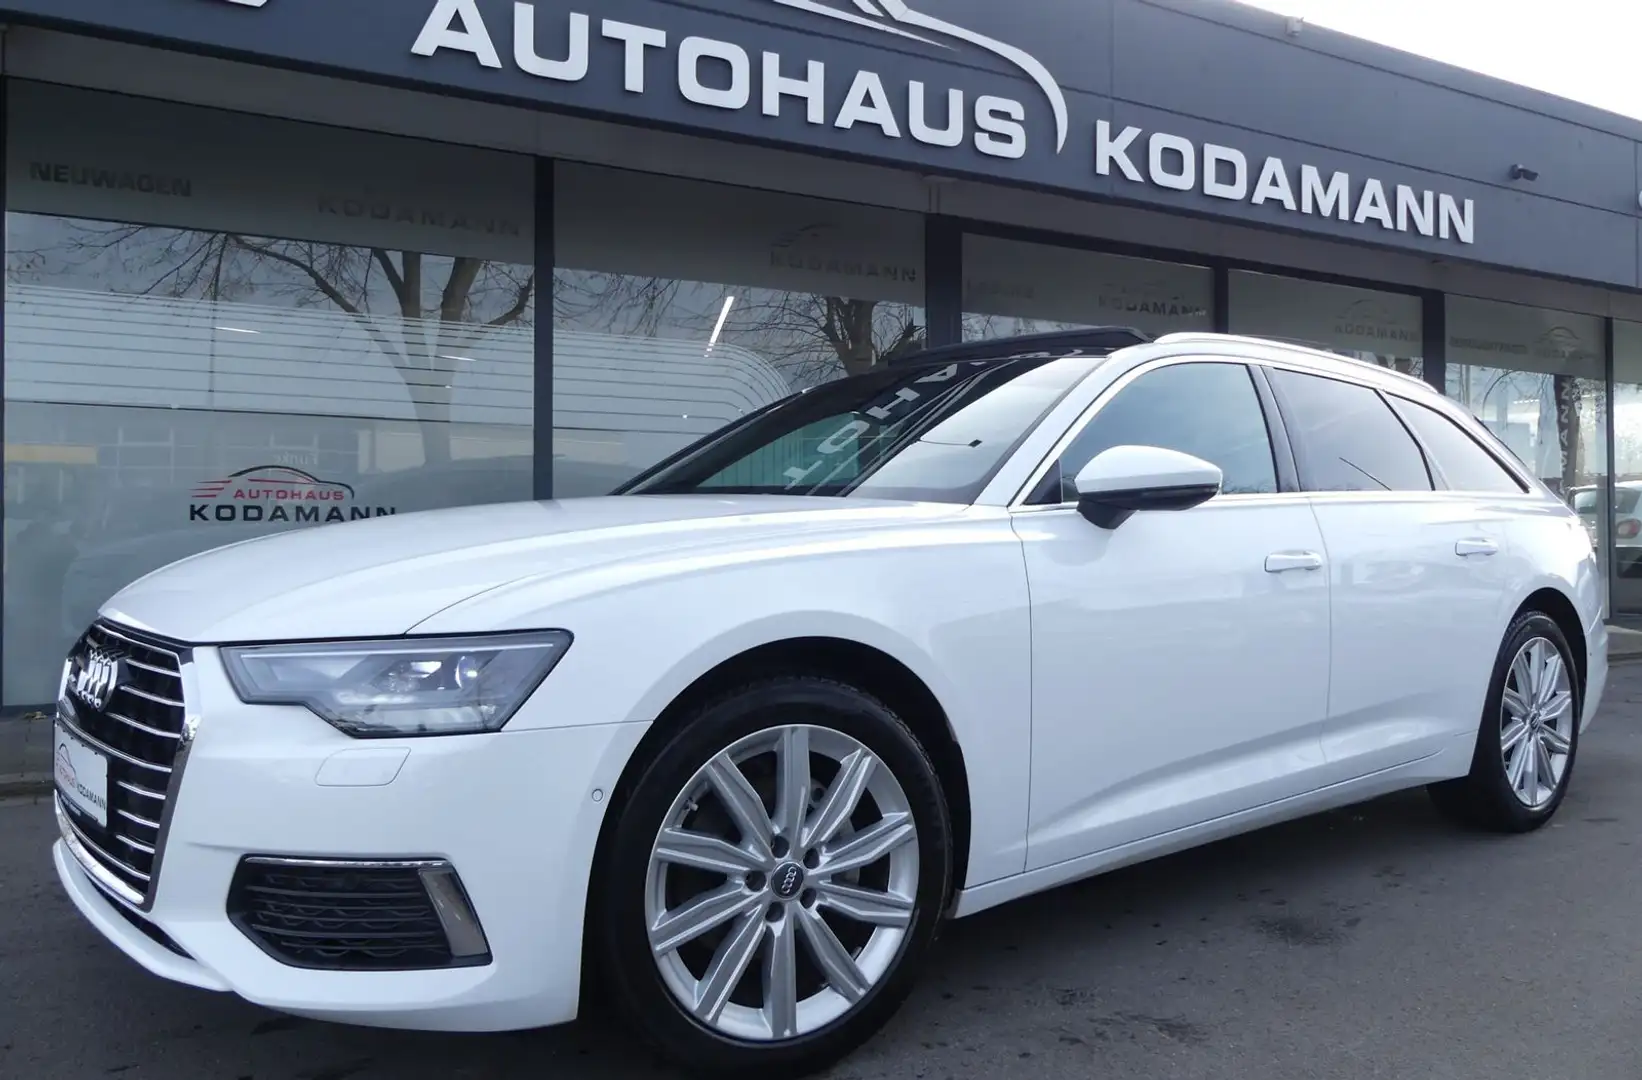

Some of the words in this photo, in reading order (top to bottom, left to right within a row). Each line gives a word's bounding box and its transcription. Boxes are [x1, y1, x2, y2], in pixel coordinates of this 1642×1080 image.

[411, 0, 1027, 159] AUTOHAUS
[1096, 119, 1475, 244] KODAMANN
[29, 160, 193, 197] NEUWAGEN
[233, 488, 345, 502] AUTOHAUS
[189, 503, 396, 523] KODAMANN
